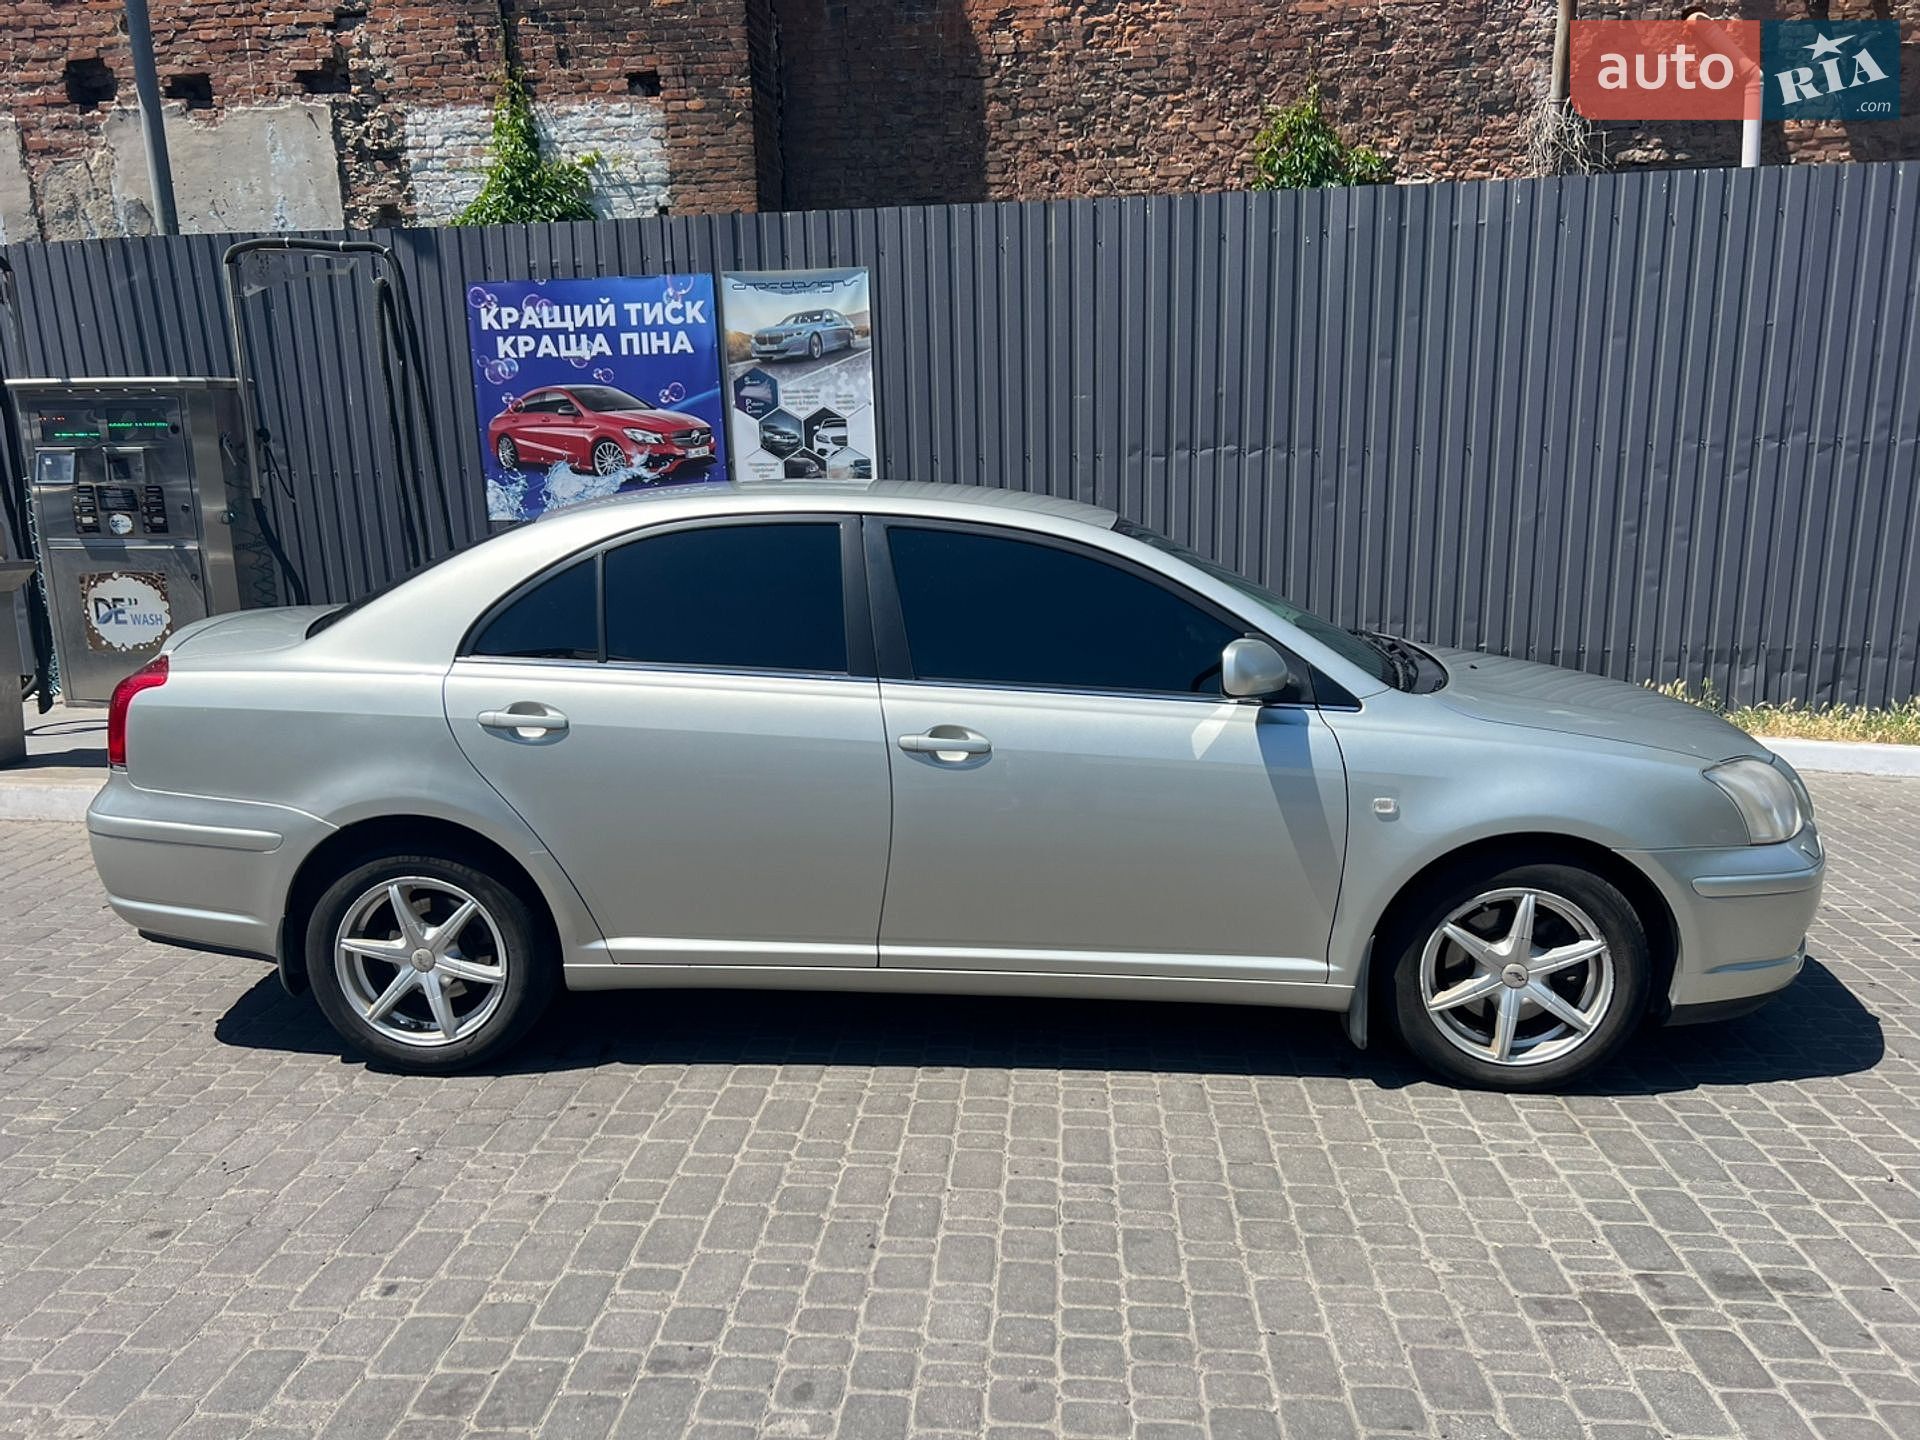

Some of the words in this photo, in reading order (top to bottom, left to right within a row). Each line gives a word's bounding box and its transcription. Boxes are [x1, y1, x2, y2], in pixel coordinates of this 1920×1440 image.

[480, 297, 617, 331] КРАЩИЙ
[624, 299, 707, 326] ТИСК
[496, 333, 612, 360] КРАЩА
[620, 330, 695, 356] ПІНА
[130, 613, 163, 626] WASH
